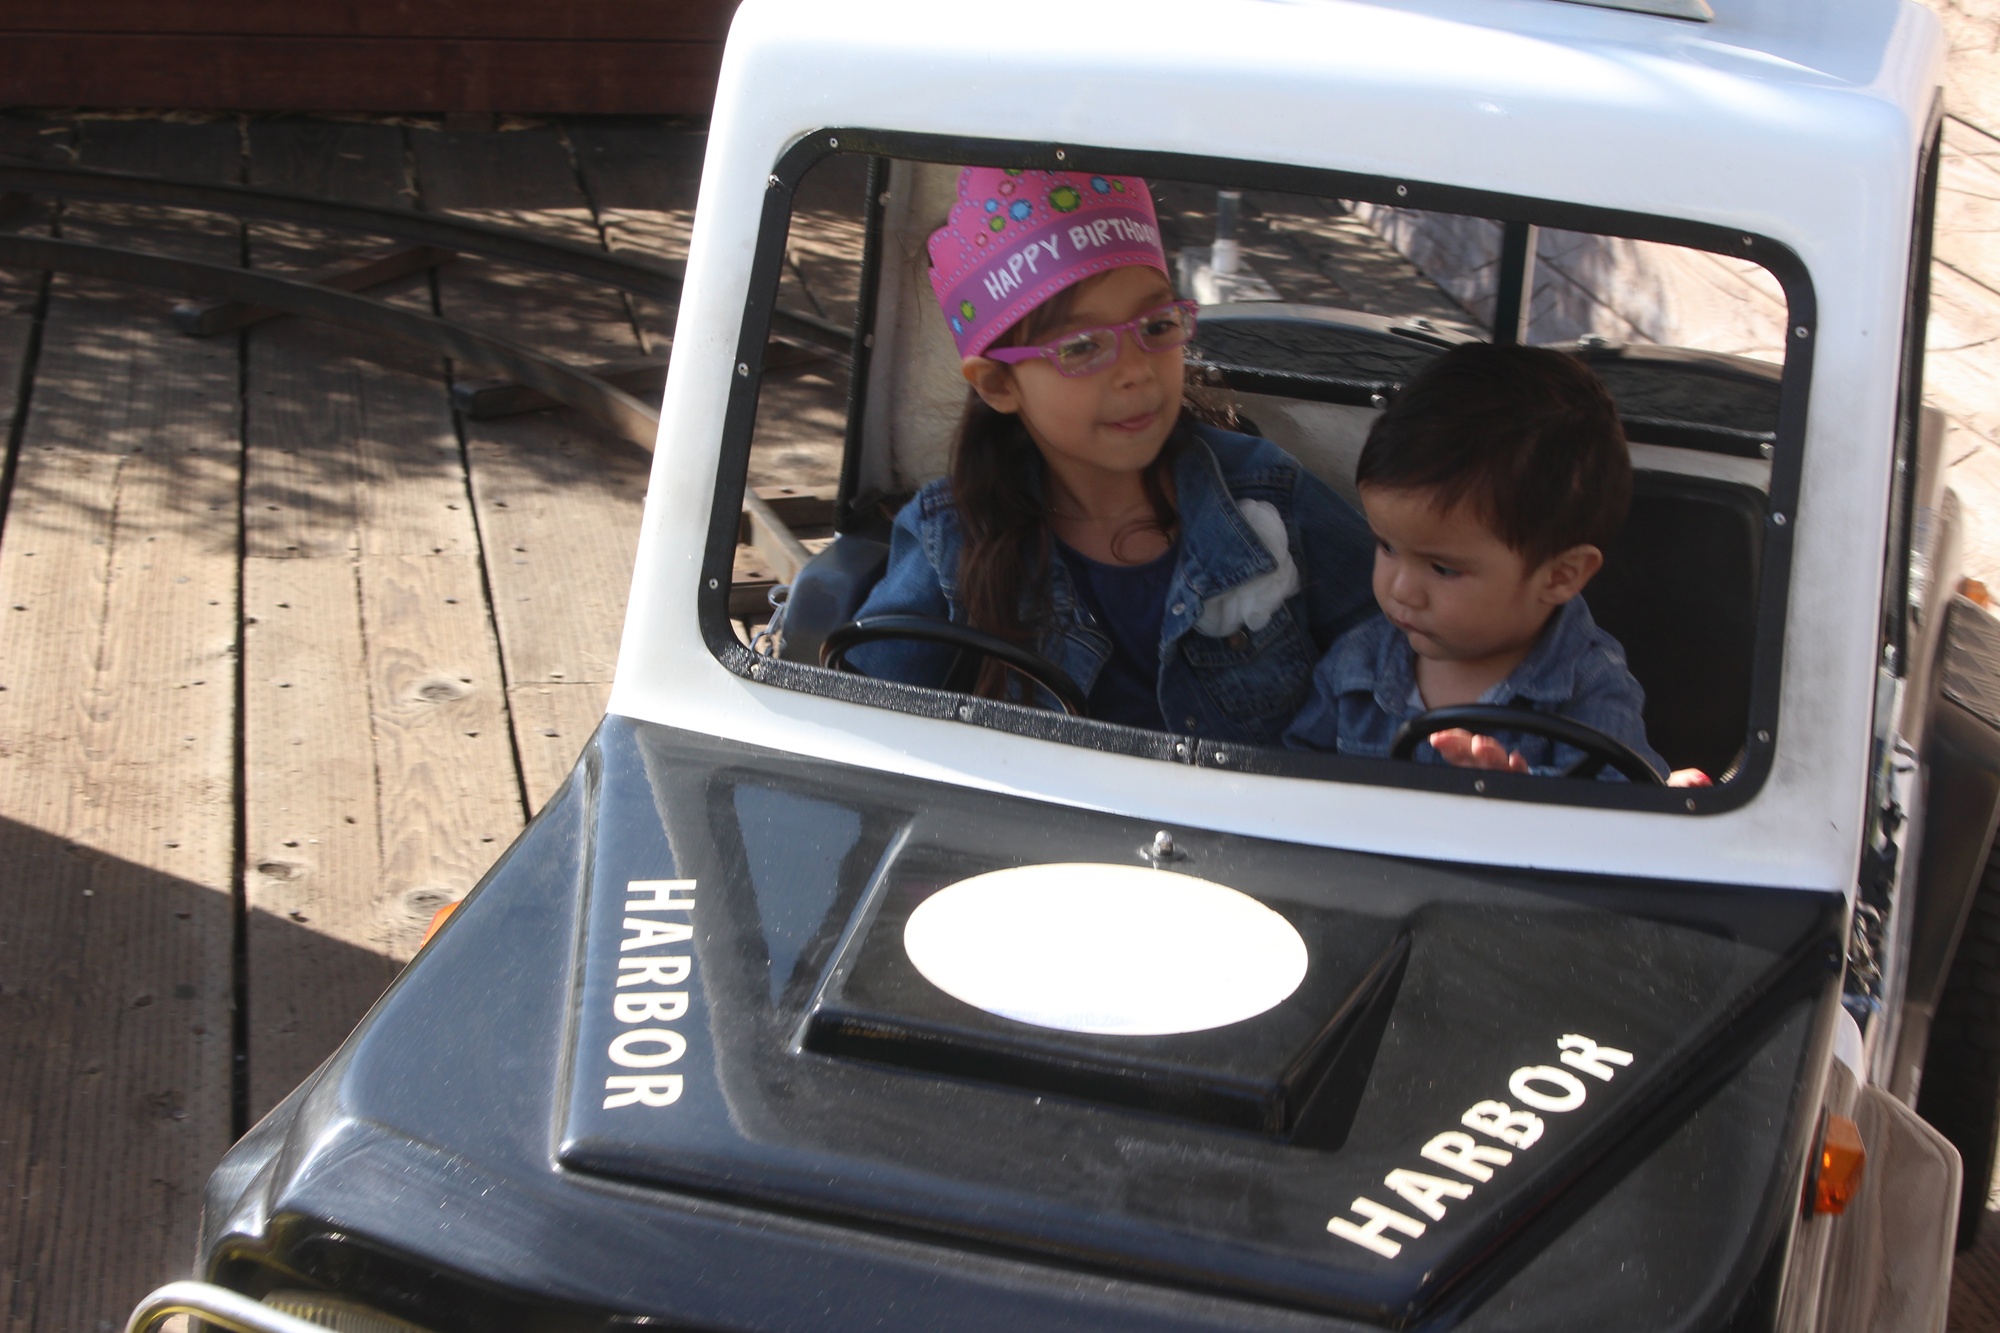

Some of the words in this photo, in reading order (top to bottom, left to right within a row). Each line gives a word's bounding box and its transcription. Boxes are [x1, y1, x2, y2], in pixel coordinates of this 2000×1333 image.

[983, 234, 1060, 301] HAPPY
[602, 879, 697, 1110] HARBOR
[1326, 1034, 1634, 1259] HARBOR
